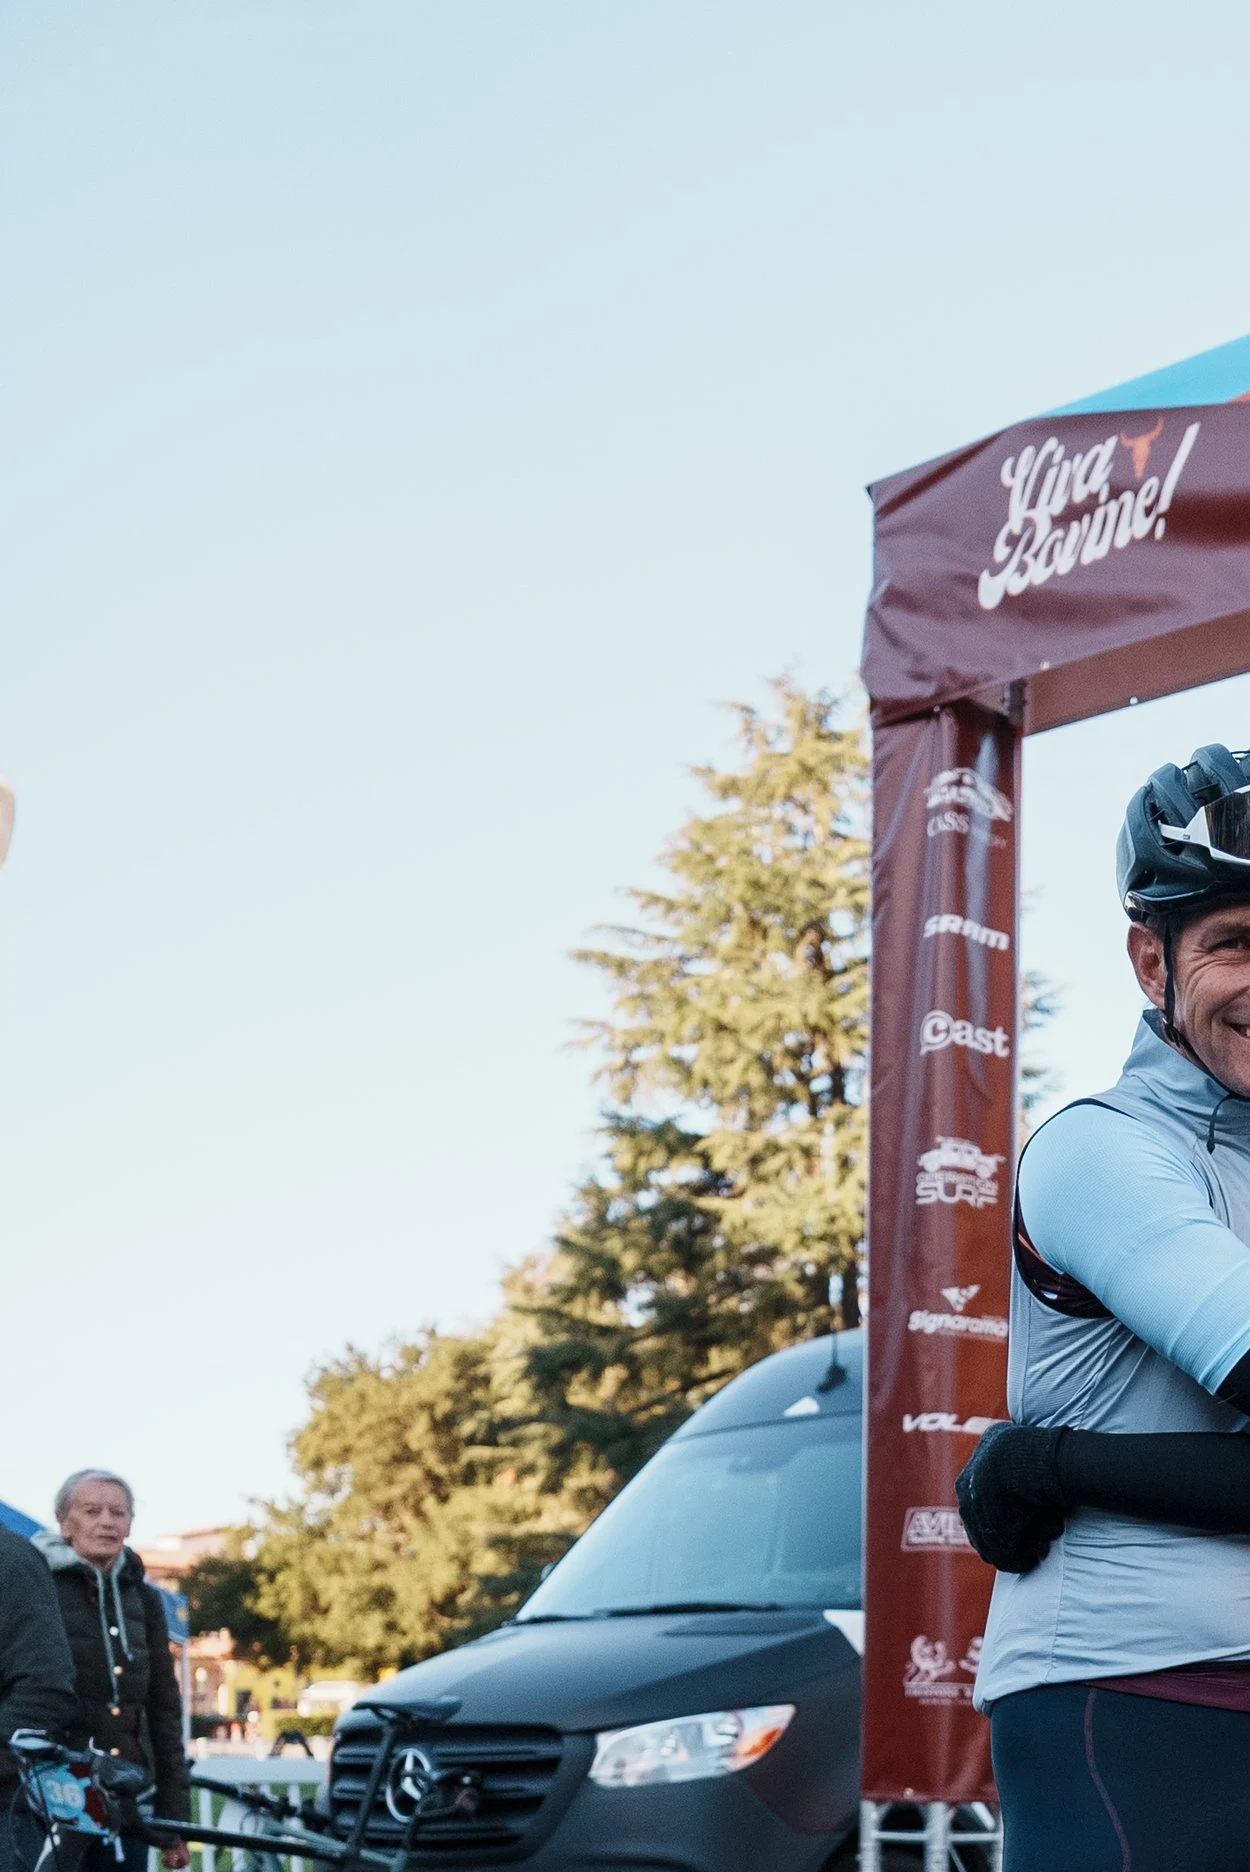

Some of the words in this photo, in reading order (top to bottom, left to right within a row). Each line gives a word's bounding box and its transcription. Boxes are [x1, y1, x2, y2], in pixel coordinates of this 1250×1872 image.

[977, 421, 1201, 610] Bovine!
[1001, 436, 1119, 535] Viva
[915, 1182, 999, 1209] SURF
[902, 1411, 1012, 1434] VOLE
